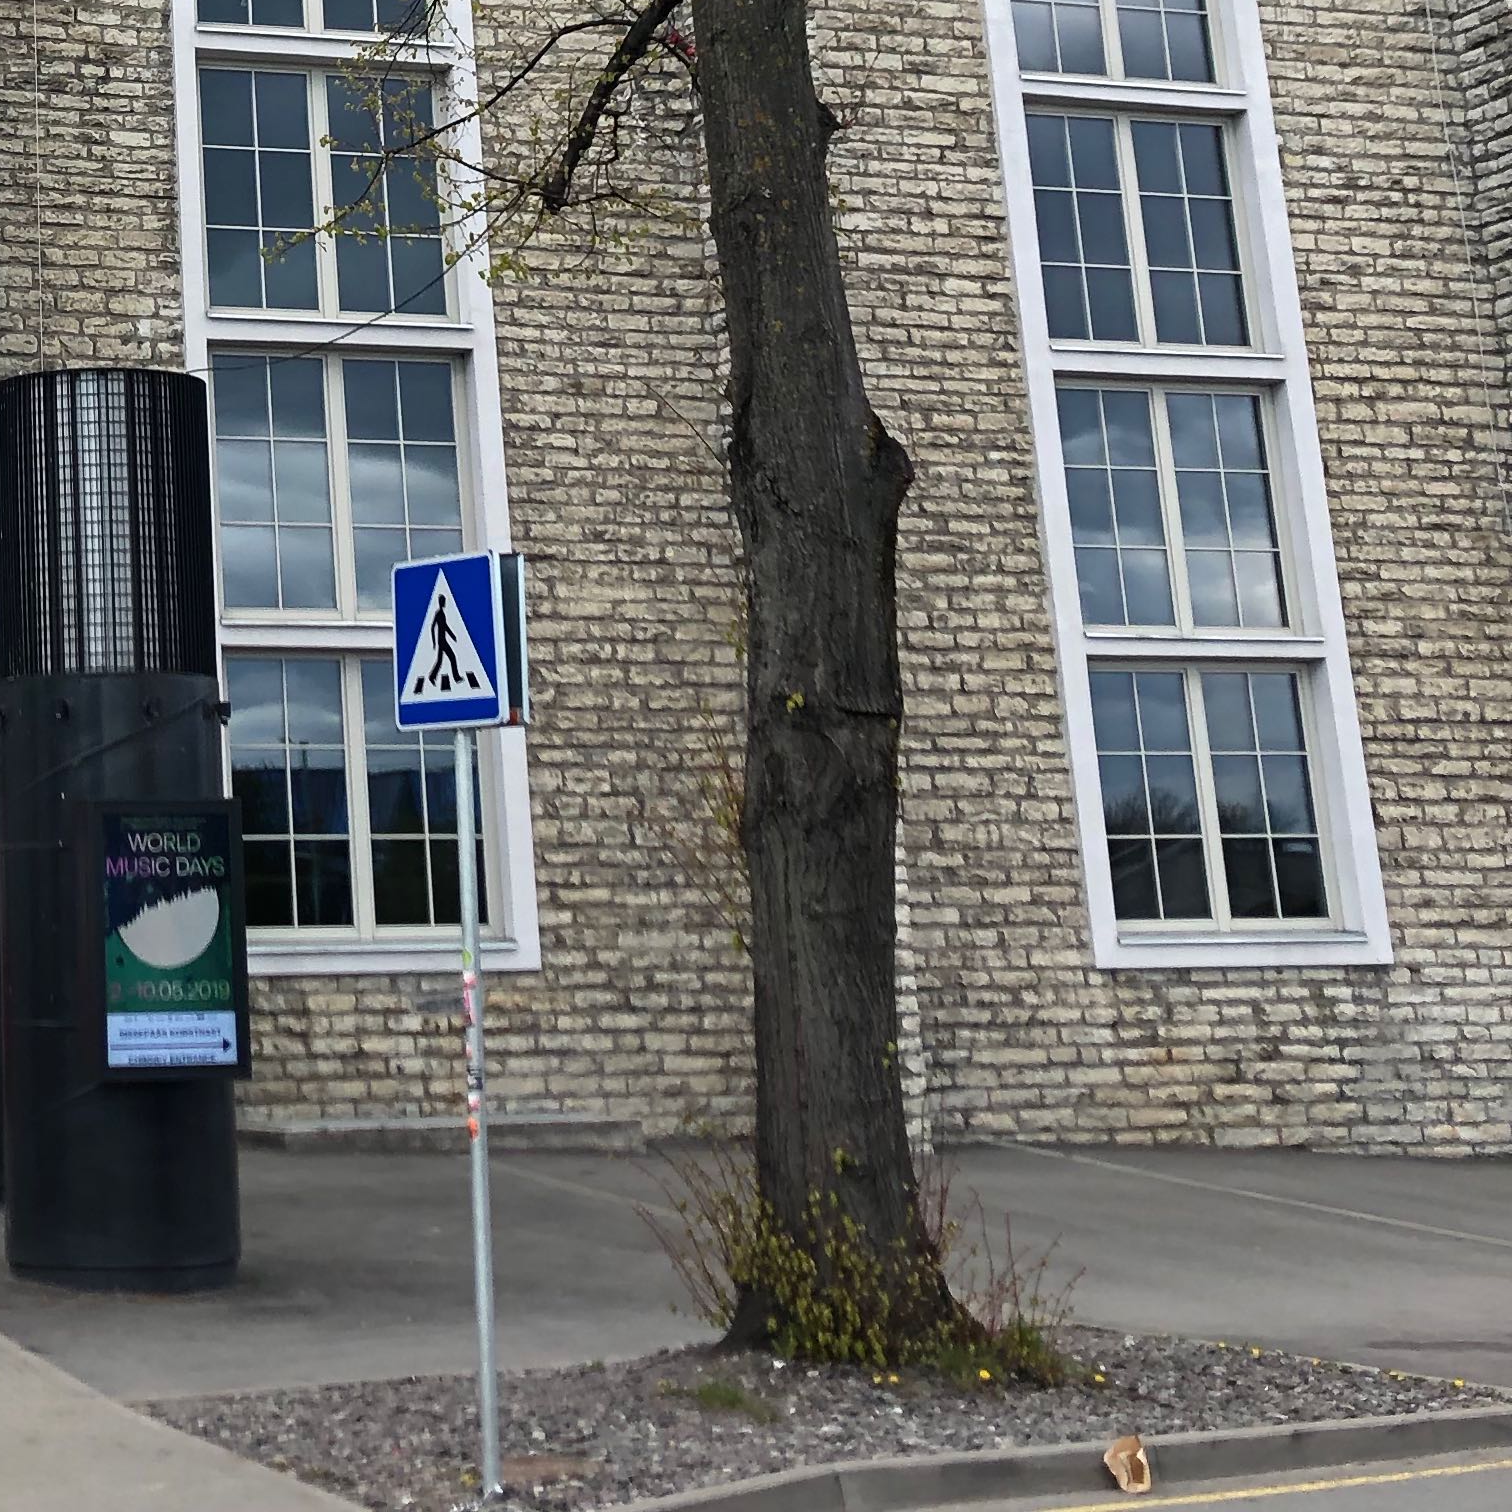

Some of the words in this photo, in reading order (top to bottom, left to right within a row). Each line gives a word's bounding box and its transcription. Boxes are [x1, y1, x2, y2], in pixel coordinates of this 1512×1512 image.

[127, 832, 201, 853] WORLD
[105, 856, 171, 877] MUSIC
[175, 855, 225, 877] DAYS
